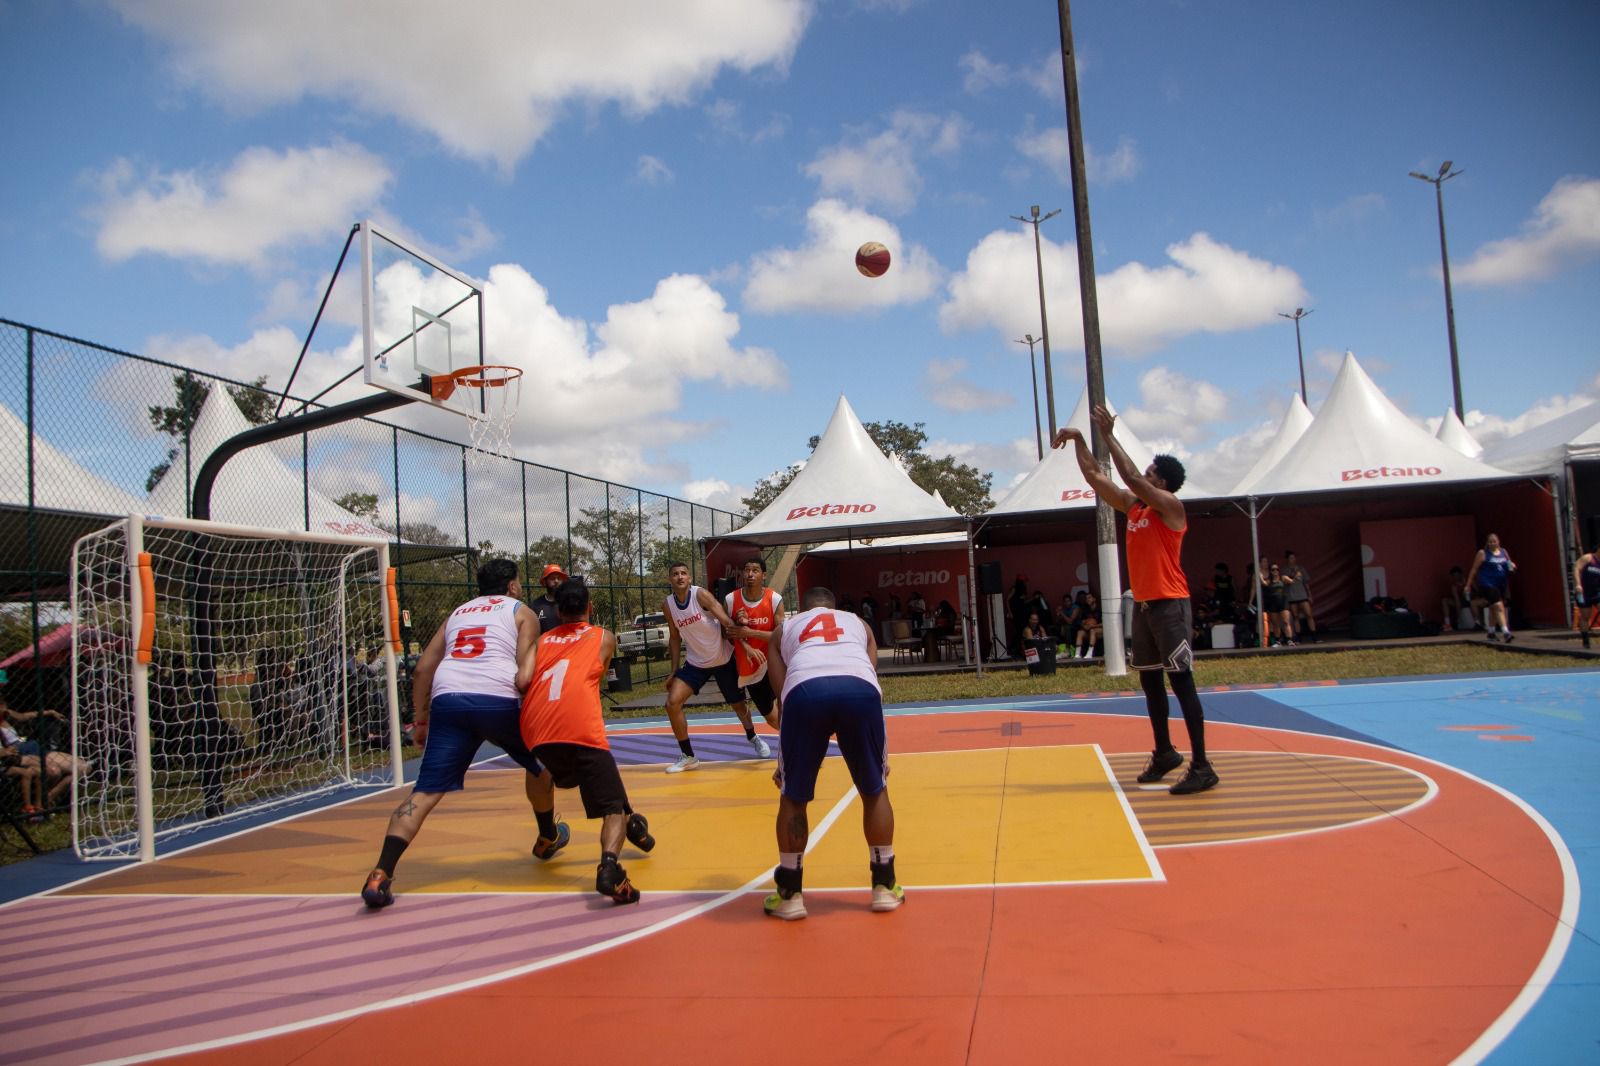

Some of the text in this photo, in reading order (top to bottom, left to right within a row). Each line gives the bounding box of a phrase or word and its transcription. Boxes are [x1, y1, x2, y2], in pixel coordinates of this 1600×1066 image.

[1342, 466, 1442, 481] Betano
[785, 503, 876, 521] Betano
[878, 569, 950, 588] Betano
[799, 613, 845, 644] 4
[450, 626, 487, 659] 5
[541, 658, 570, 702] 1
